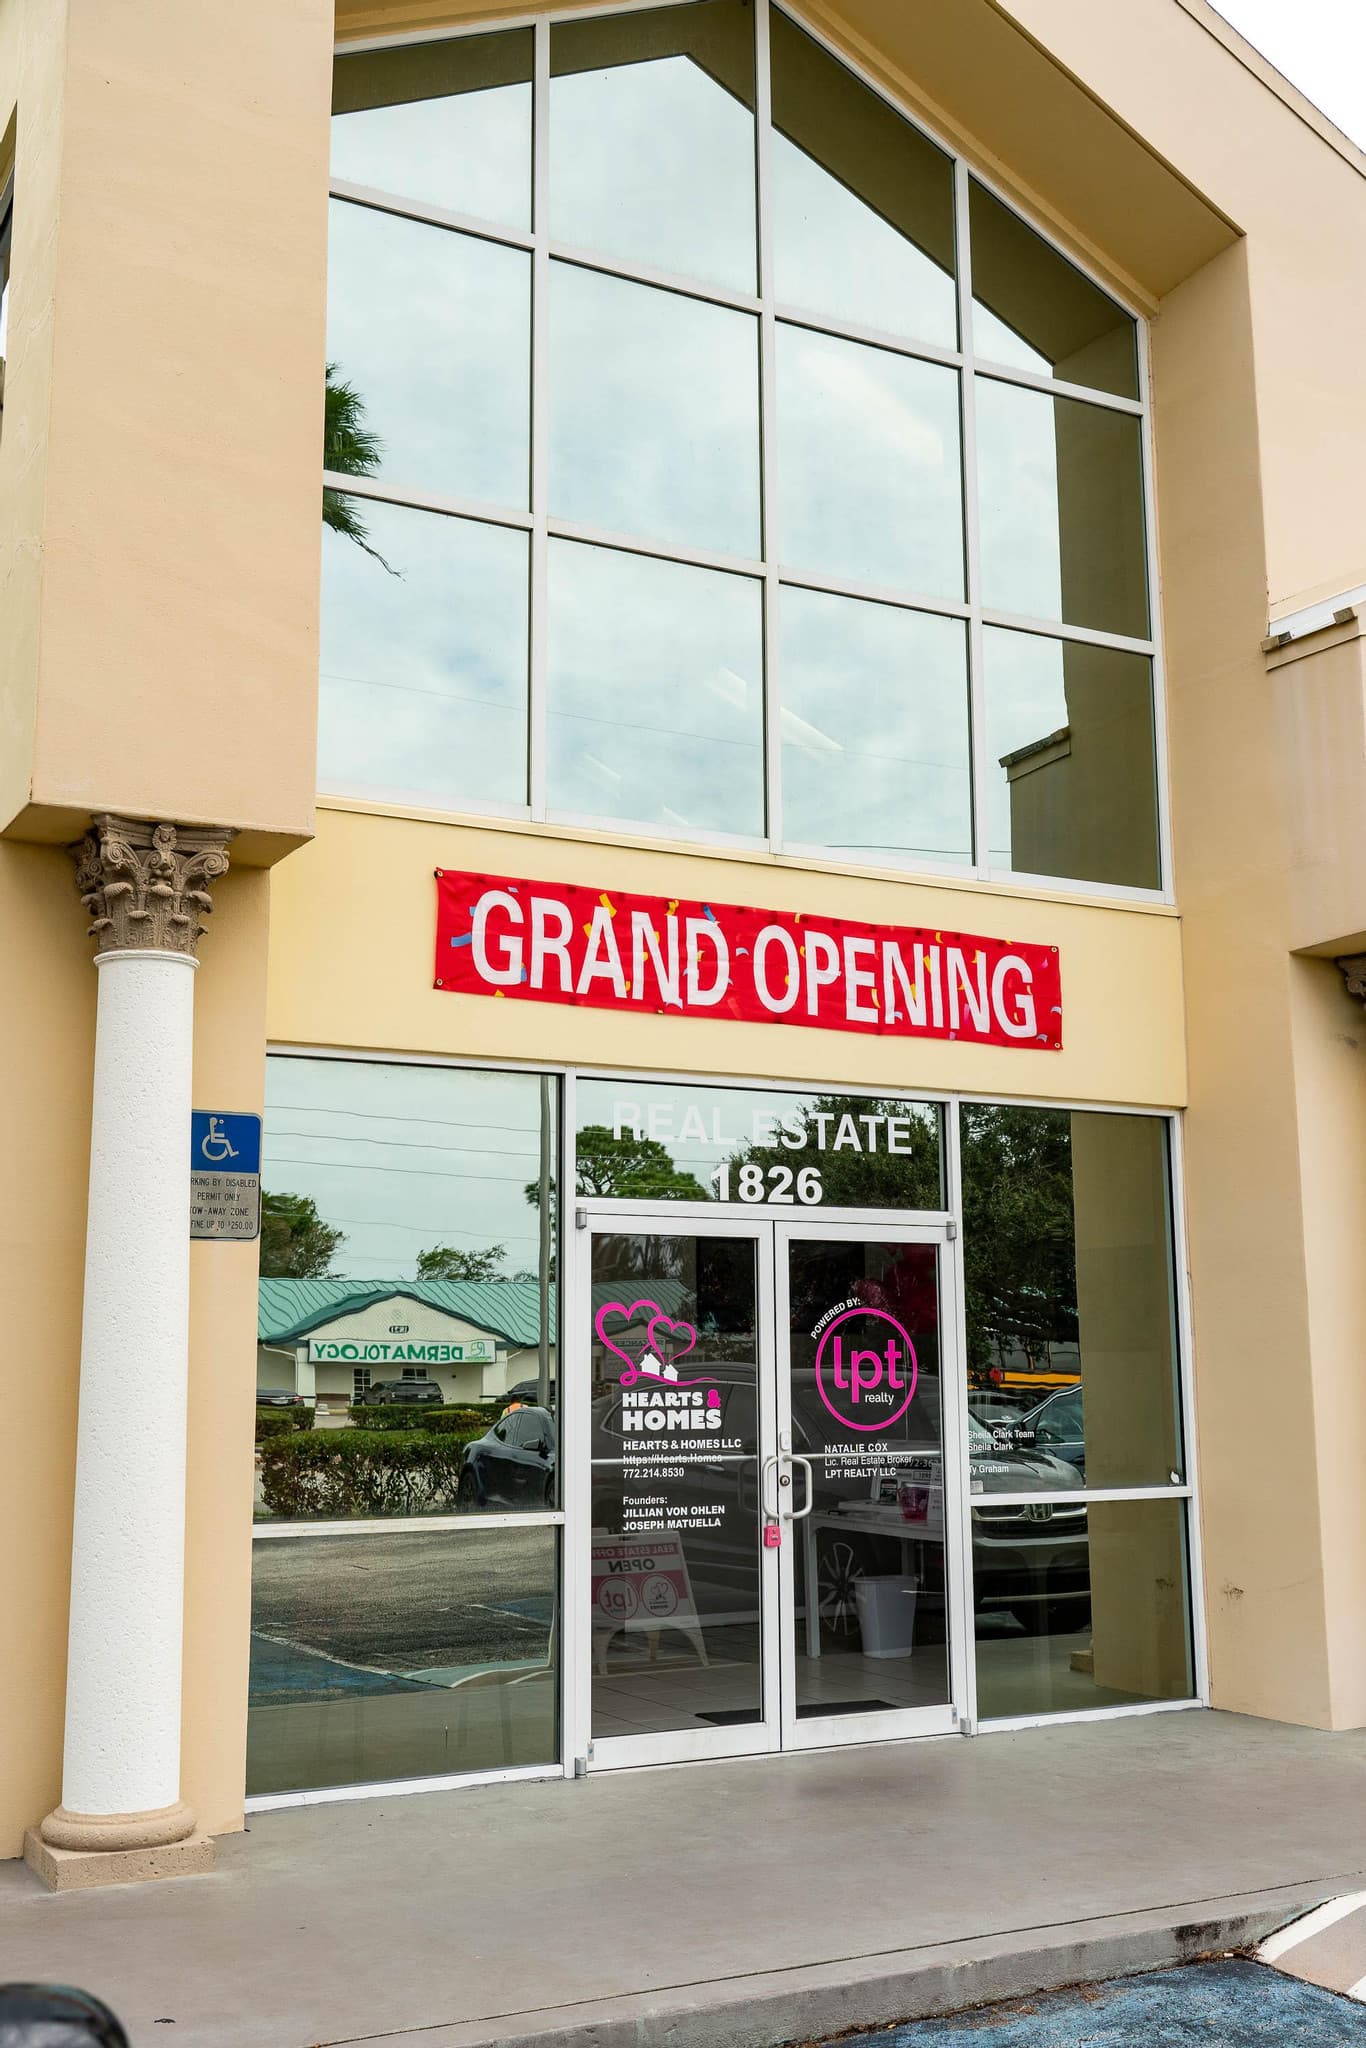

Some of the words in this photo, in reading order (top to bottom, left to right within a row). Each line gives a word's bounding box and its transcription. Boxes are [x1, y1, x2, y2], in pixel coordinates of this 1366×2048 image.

[471, 889, 730, 1006] GRAND
[752, 924, 1038, 1038] OPENING
[613, 1101, 736, 1146] REAL
[751, 1109, 912, 1155] ESTATE
[190, 1177, 210, 1186] RKING
[212, 1178, 222, 1186] BY
[226, 1178, 257, 1188] DISABLED
[711, 1163, 823, 1205] 1826
[197, 1192, 221, 1200] PERMIT
[224, 1192, 240, 1201] ONLY
[230, 1207, 249, 1216] ZONE
[190, 1220, 204, 1228] FINE
[206, 1220, 214, 1228] UP
[218, 1221, 224, 1229] TO
[810, 1302, 846, 1340] POWERED
[846, 1296, 861, 1308] BY:
[833, 1336, 904, 1404] lpt
[622, 1391, 703, 1408] HEARTS
[707, 1388, 722, 1408] &
[864, 1392, 894, 1406] realty
[622, 1409, 722, 1431] HOMES
[968, 1430, 991, 1439] Sheila
[992, 1430, 1013, 1438] Clark
[1014, 1430, 1034, 1438] Team
[623, 1440, 669, 1450] HEARTS
[671, 1440, 679, 1450] &
[680, 1438, 720, 1450] HOMES
[722, 1438, 742, 1448] LLC
[824, 1444, 865, 1454] NATALIE
[868, 1442, 888, 1452] COX
[968, 1443, 992, 1451] Sheila
[993, 1442, 1014, 1450] Clark
[824, 1456, 838, 1466] Lic.
[841, 1456, 858, 1466] Real
[861, 1456, 884, 1466] Estate
[887, 1455, 912, 1464] Broker
[623, 1468, 685, 1478] 772.214.8530
[825, 1470, 842, 1479] LPT
[844, 1468, 877, 1478] REALTY
[880, 1467, 896, 1476] LLC
[979, 1464, 1009, 1473] Graham
[622, 1496, 668, 1506] Founders:
[622, 1508, 663, 1518] JILLIAN
[666, 1506, 688, 1516] VON
[690, 1505, 726, 1515] OHLEN
[622, 1520, 664, 1530] JOSEPH
[667, 1518, 722, 1528] MATUELLA
